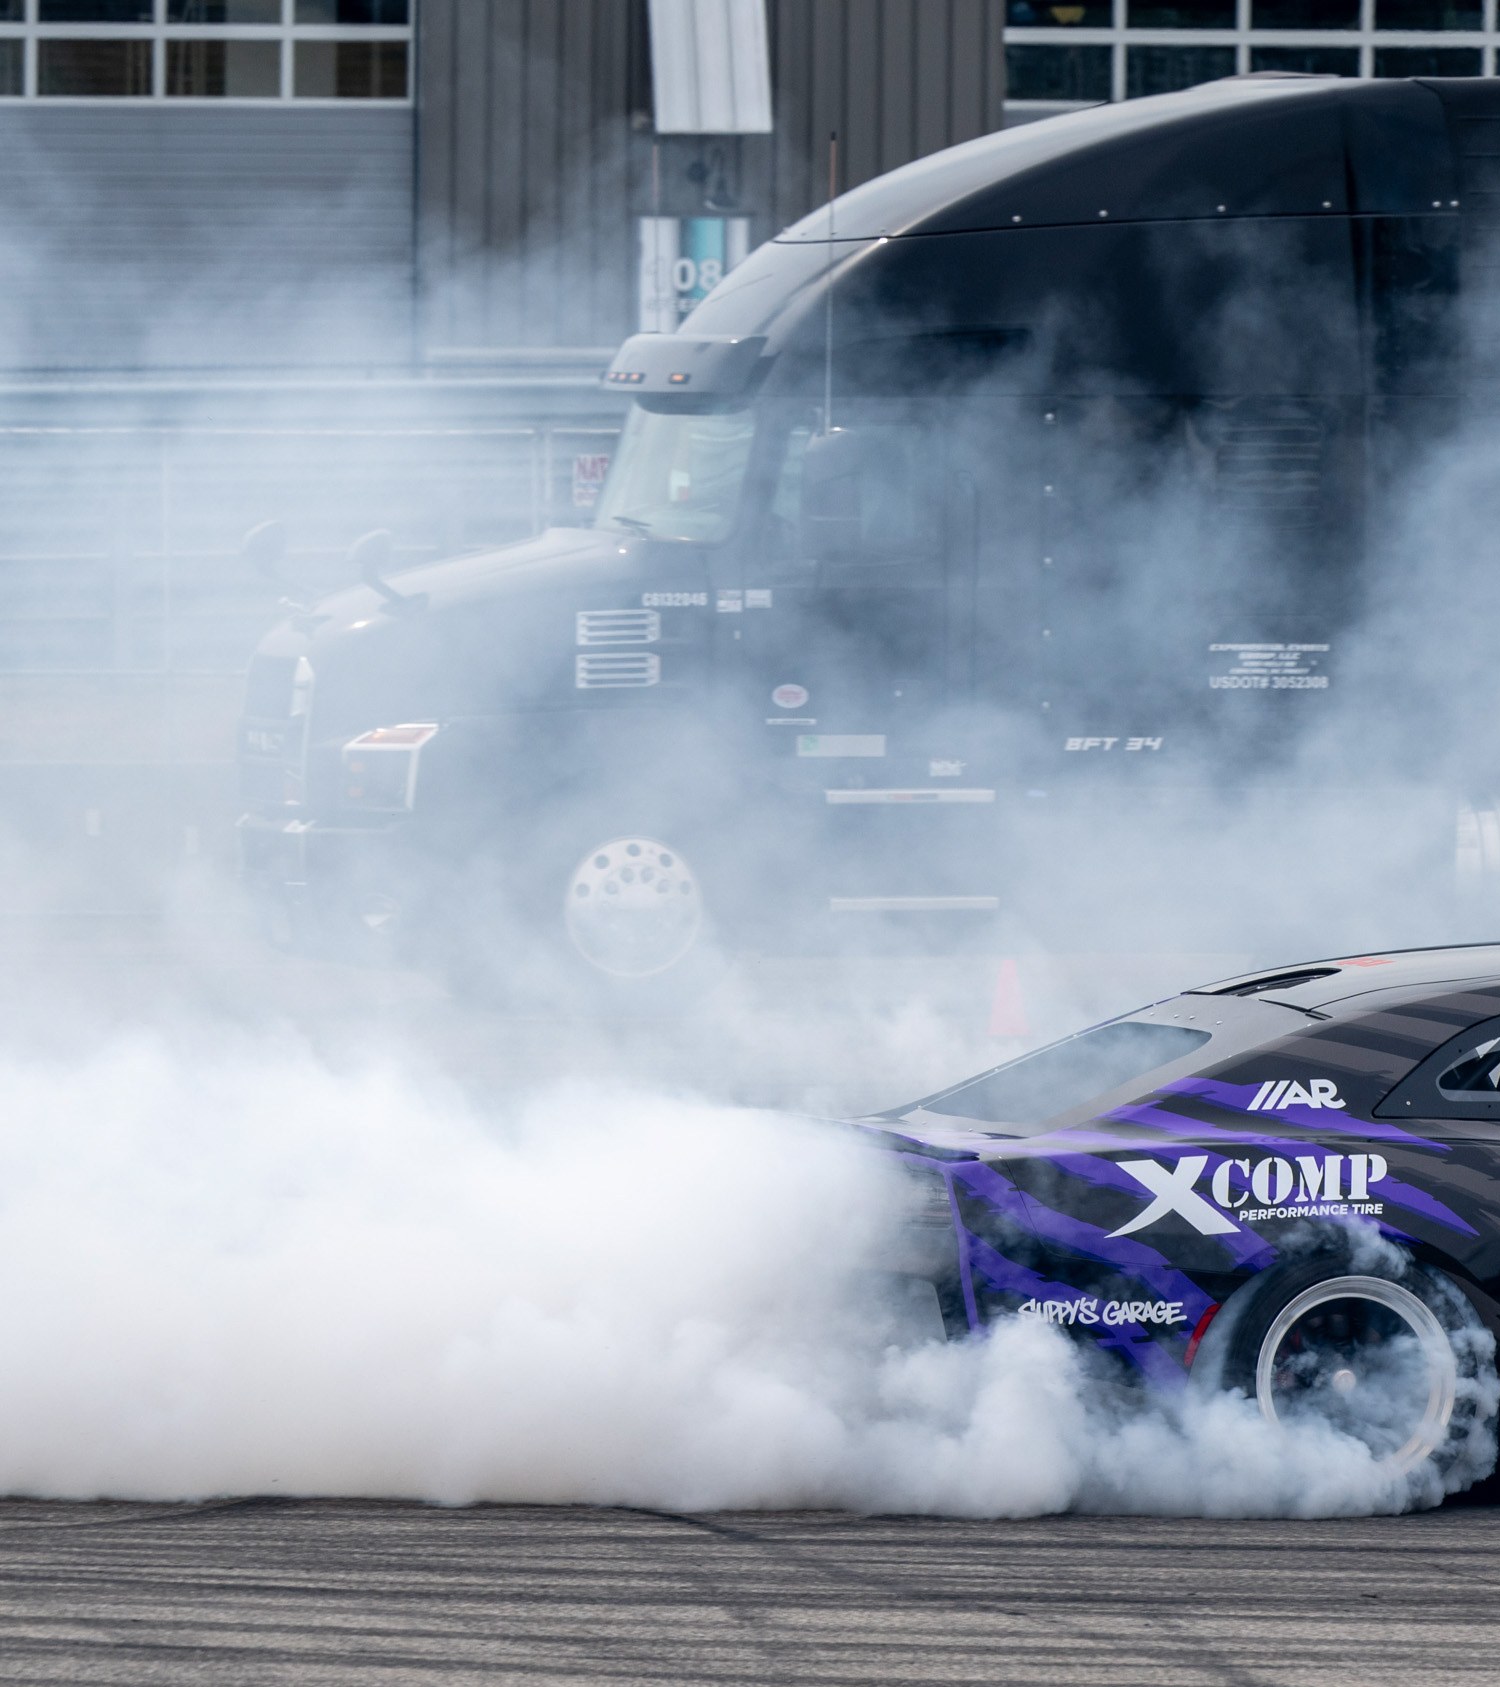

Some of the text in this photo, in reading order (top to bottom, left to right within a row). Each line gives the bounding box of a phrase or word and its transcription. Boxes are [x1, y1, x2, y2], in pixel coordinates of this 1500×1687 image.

[1209, 676, 1270, 689] USDOT#
[1064, 737, 1164, 751] BFT 34
[1238, 1203, 1384, 1222] PERFORMANCE TIRE
[1102, 1300, 1188, 1326] GARAGE
